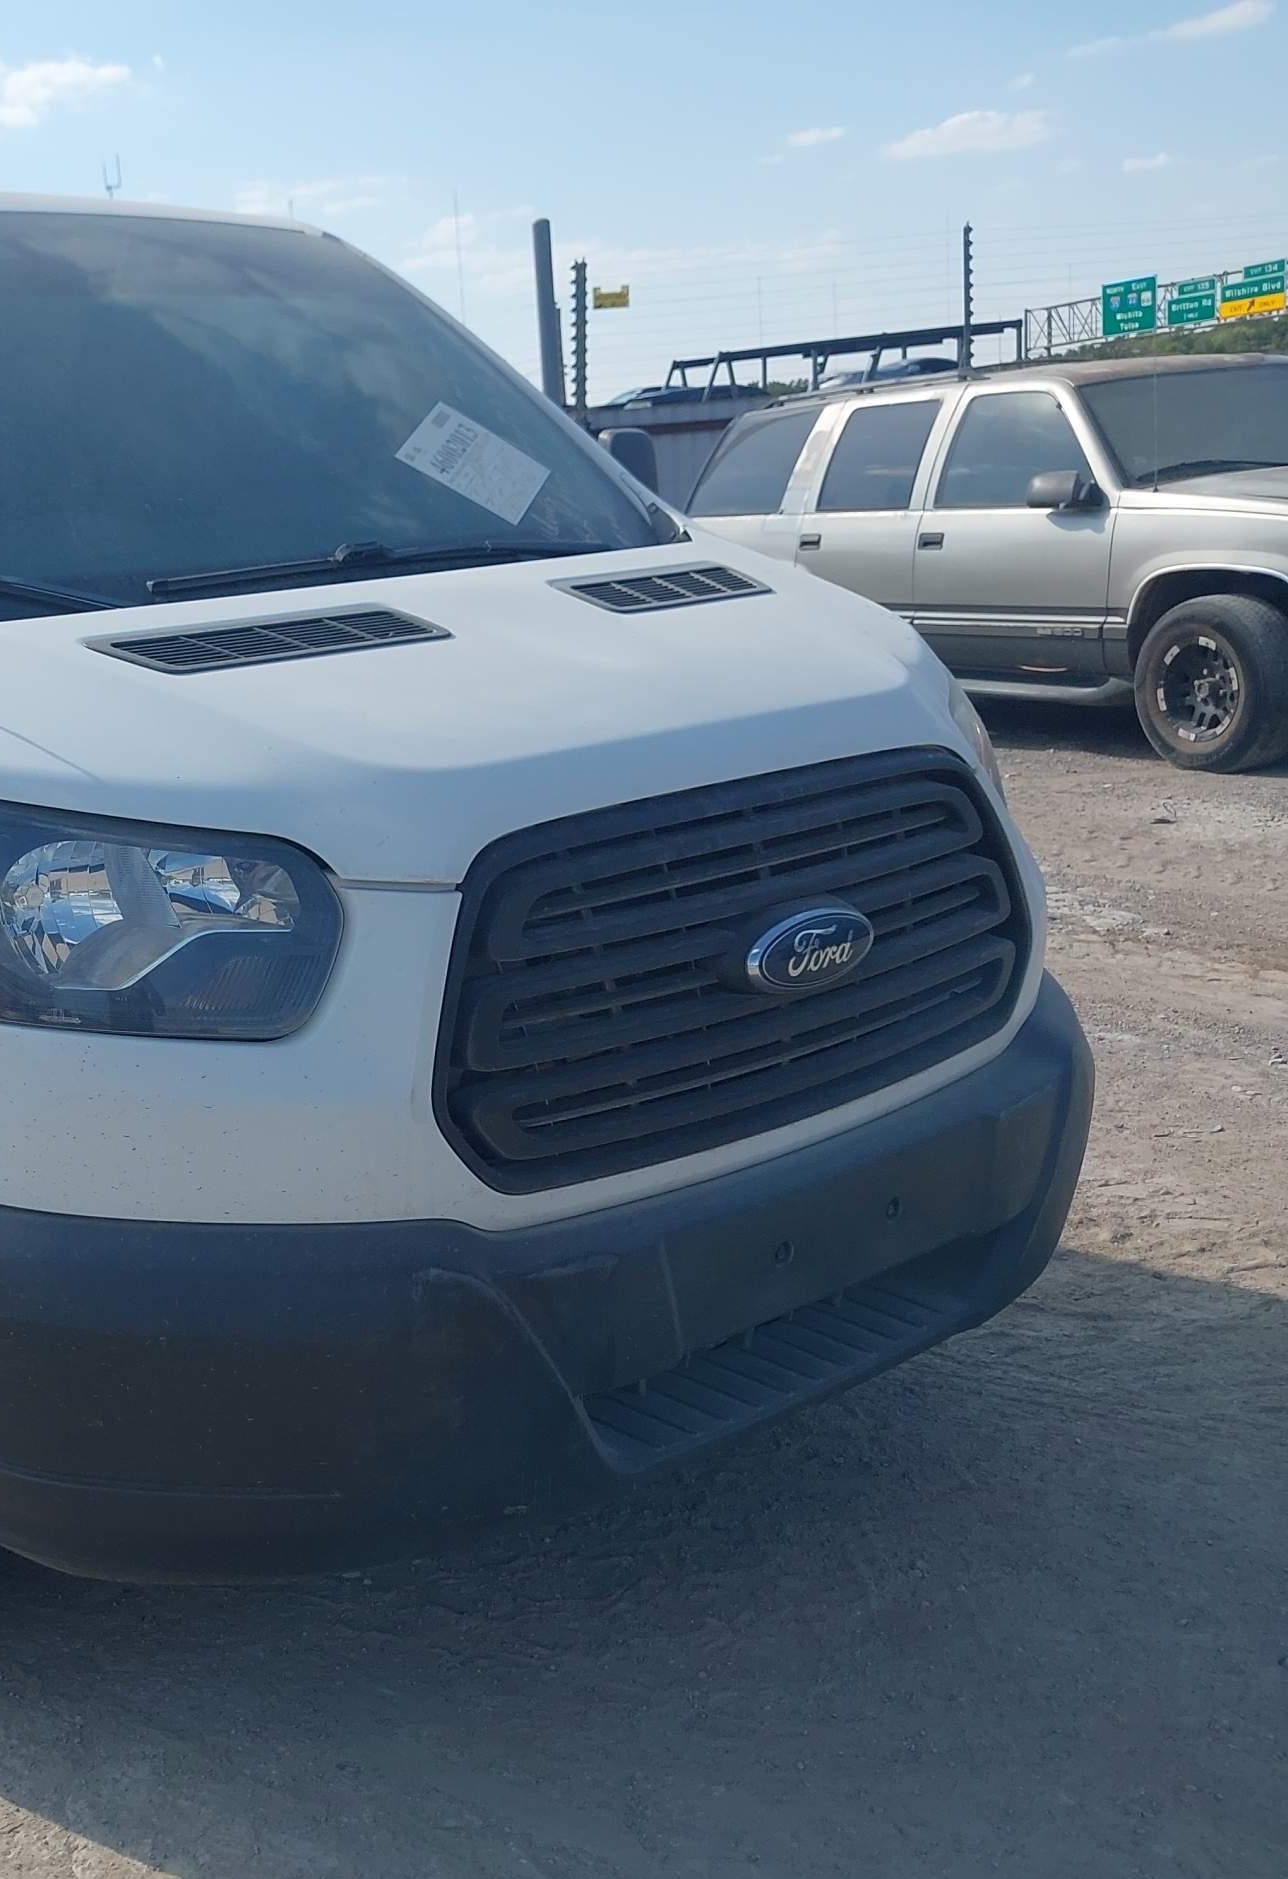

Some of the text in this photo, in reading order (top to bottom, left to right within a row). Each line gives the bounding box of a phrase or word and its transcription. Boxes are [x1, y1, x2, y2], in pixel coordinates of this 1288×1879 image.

[1265, 264, 1278, 272] 134
[1225, 281, 1281, 298] Wilshire Blvd
[1171, 298, 1212, 312] Britton Rd
[1116, 311, 1143, 320] Wichita
[1119, 322, 1140, 331] Tulsa
[788, 924, 854, 977] Ford
